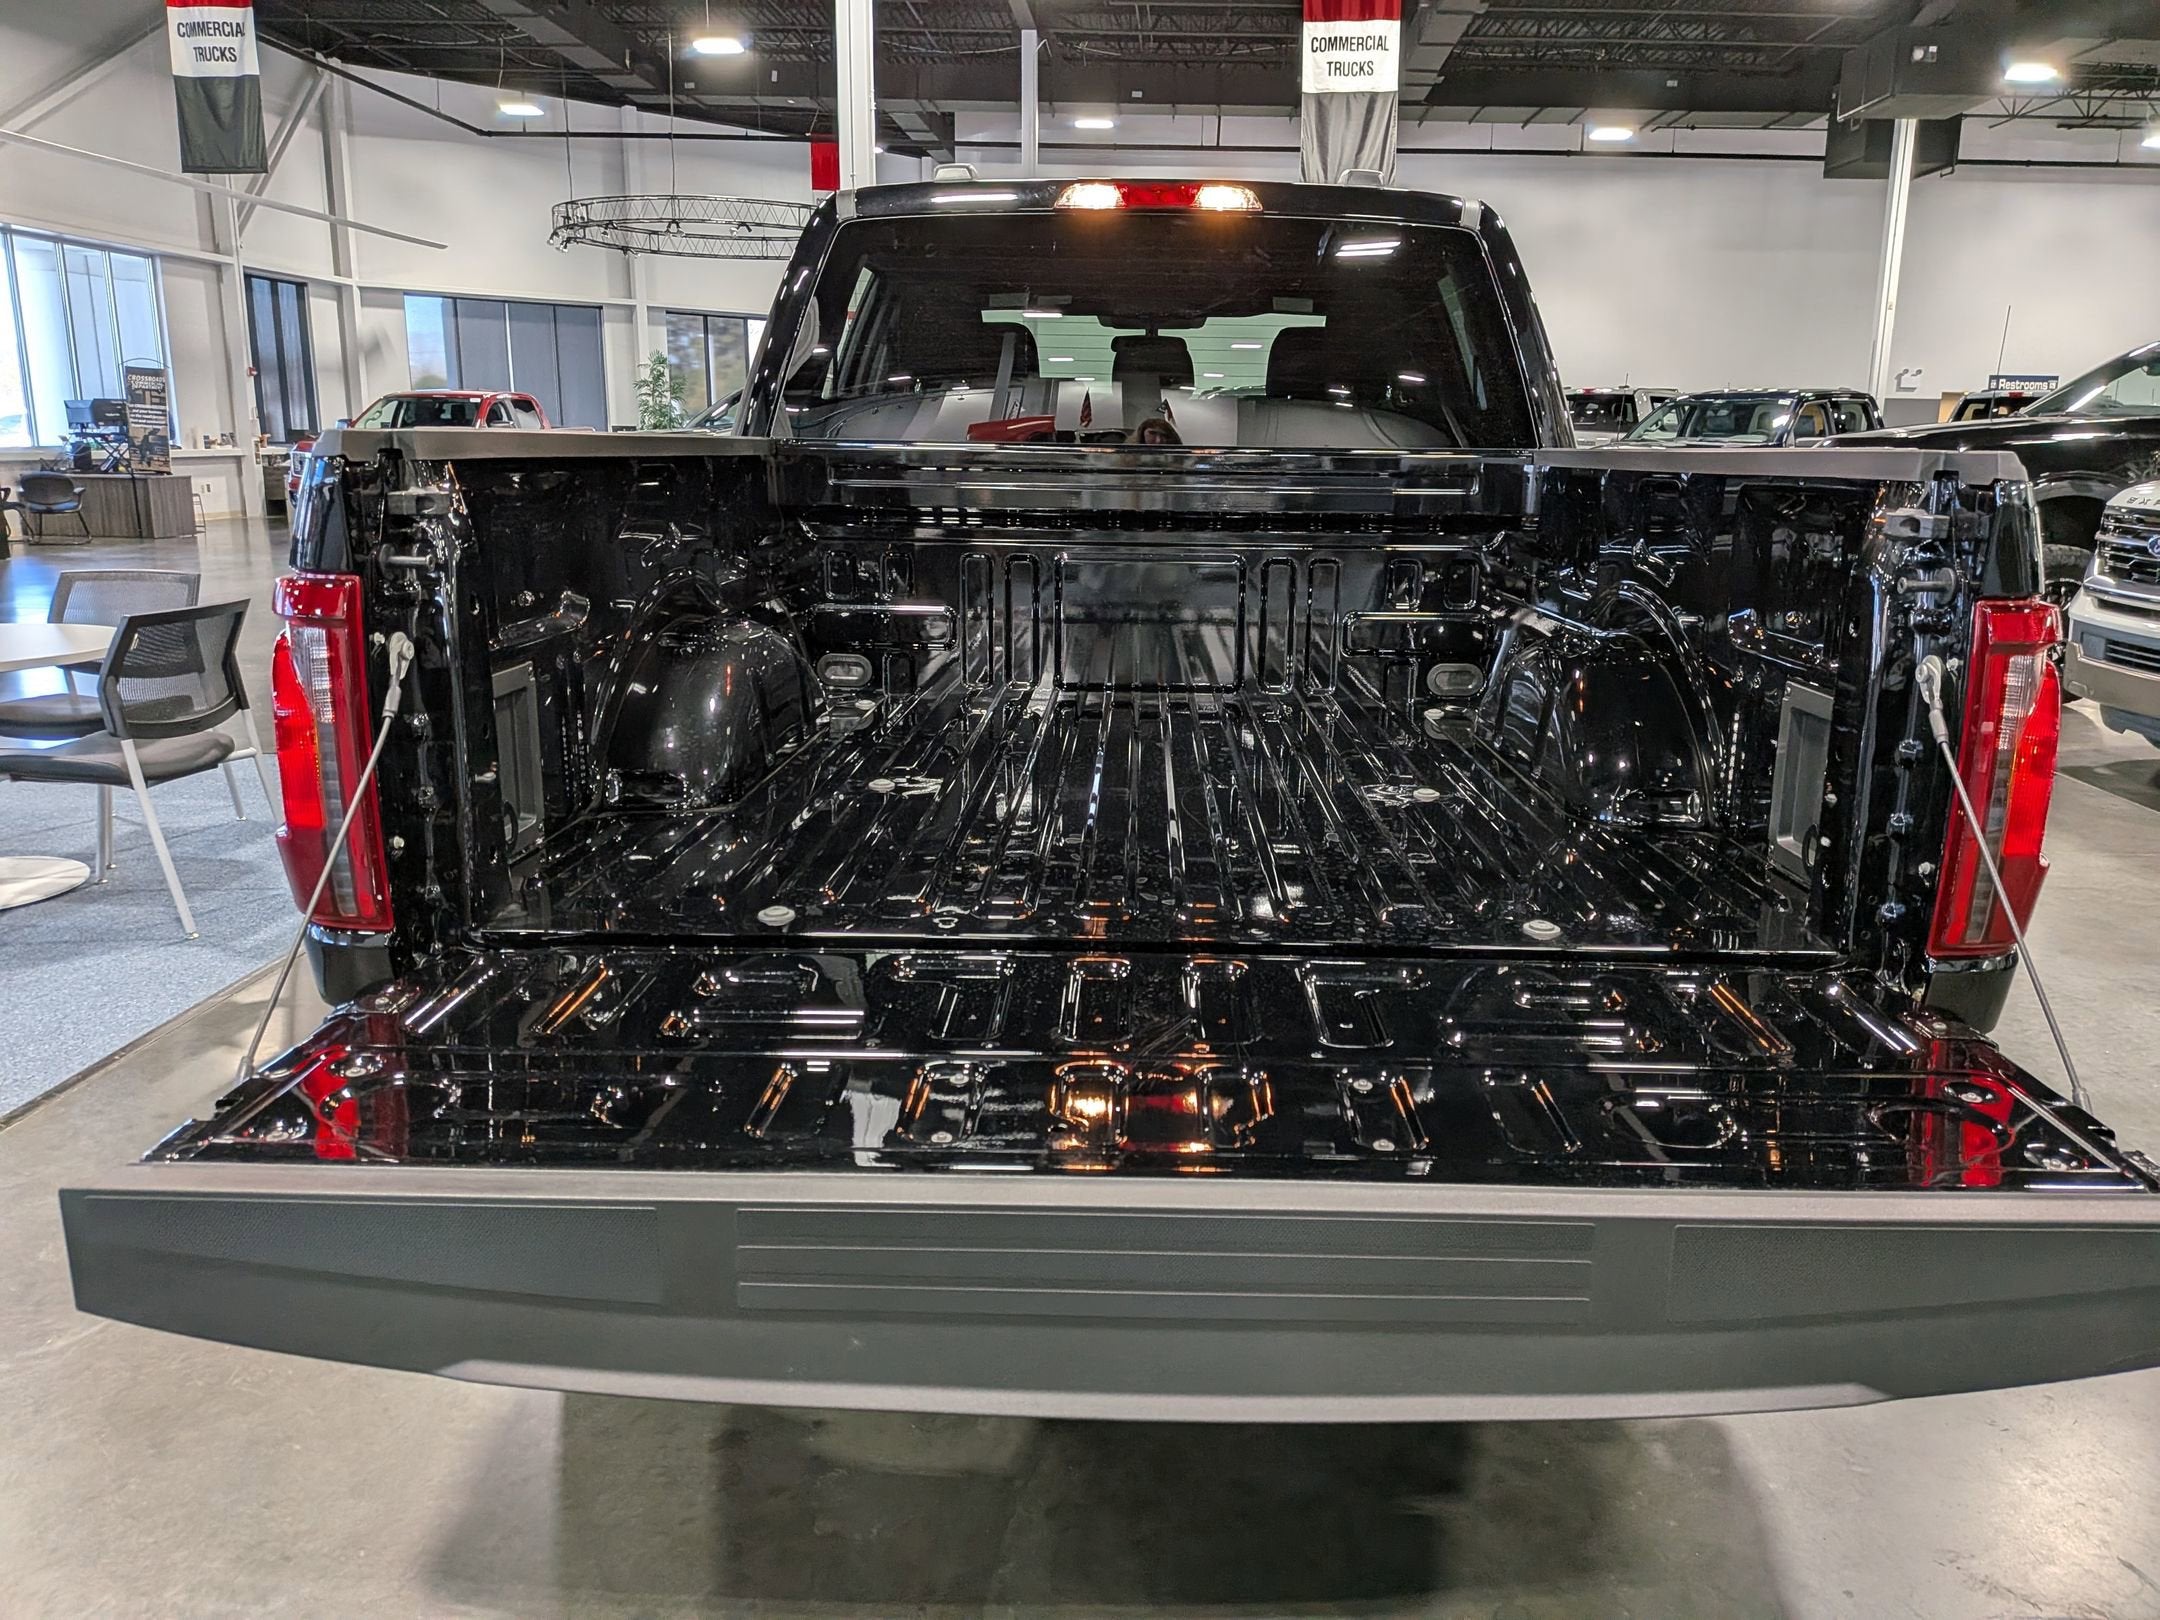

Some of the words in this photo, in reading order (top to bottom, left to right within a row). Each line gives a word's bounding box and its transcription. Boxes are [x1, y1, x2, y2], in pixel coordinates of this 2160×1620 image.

[176, 21, 246, 38] COMMERCIAL
[1311, 35, 1389, 53] COMMERCIAL
[193, 46, 238, 63] TRUCKS
[1326, 60, 1374, 77] TRUCKS
[1998, 378, 2049, 390] Restrooms
